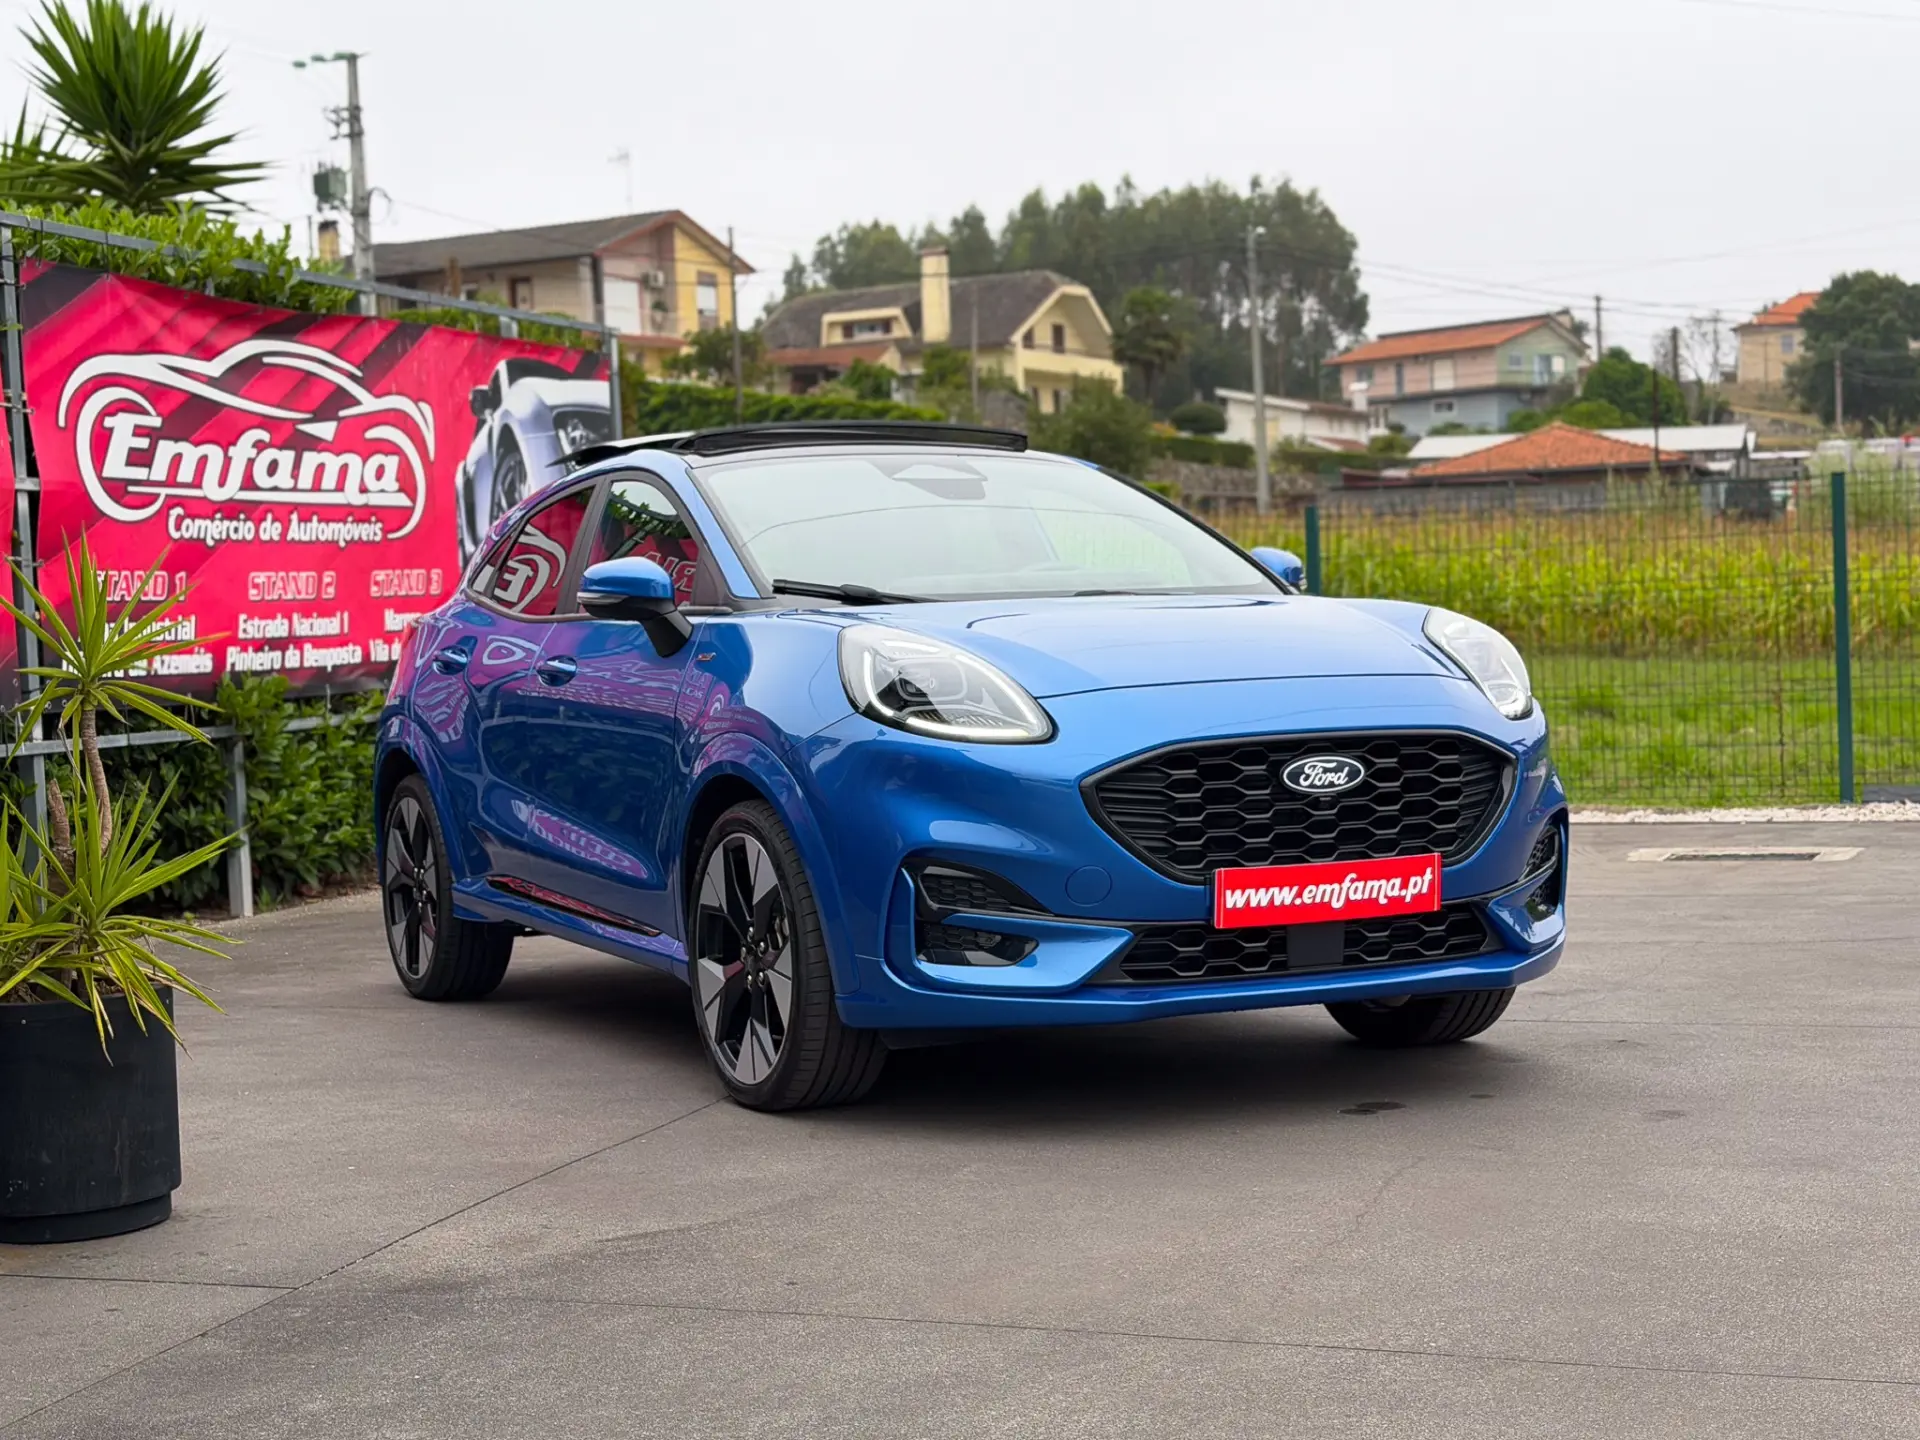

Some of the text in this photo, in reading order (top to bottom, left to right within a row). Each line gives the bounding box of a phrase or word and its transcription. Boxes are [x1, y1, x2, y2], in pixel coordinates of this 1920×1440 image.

[102, 412, 400, 505] Emfama
[168, 507, 383, 548] Comércio de Automóveis
[248, 571, 337, 601] STAND 2
[370, 569, 427, 597] STAND
[429, 568, 443, 596] 3
[238, 613, 289, 640] Estrada
[292, 611, 341, 637] Nacional
[226, 644, 282, 672] Pinheiro
[285, 643, 301, 669] da
[369, 639, 389, 662] Vila
[1299, 761, 1349, 787] Ford
[1225, 867, 1433, 909] www.emfama.pt
